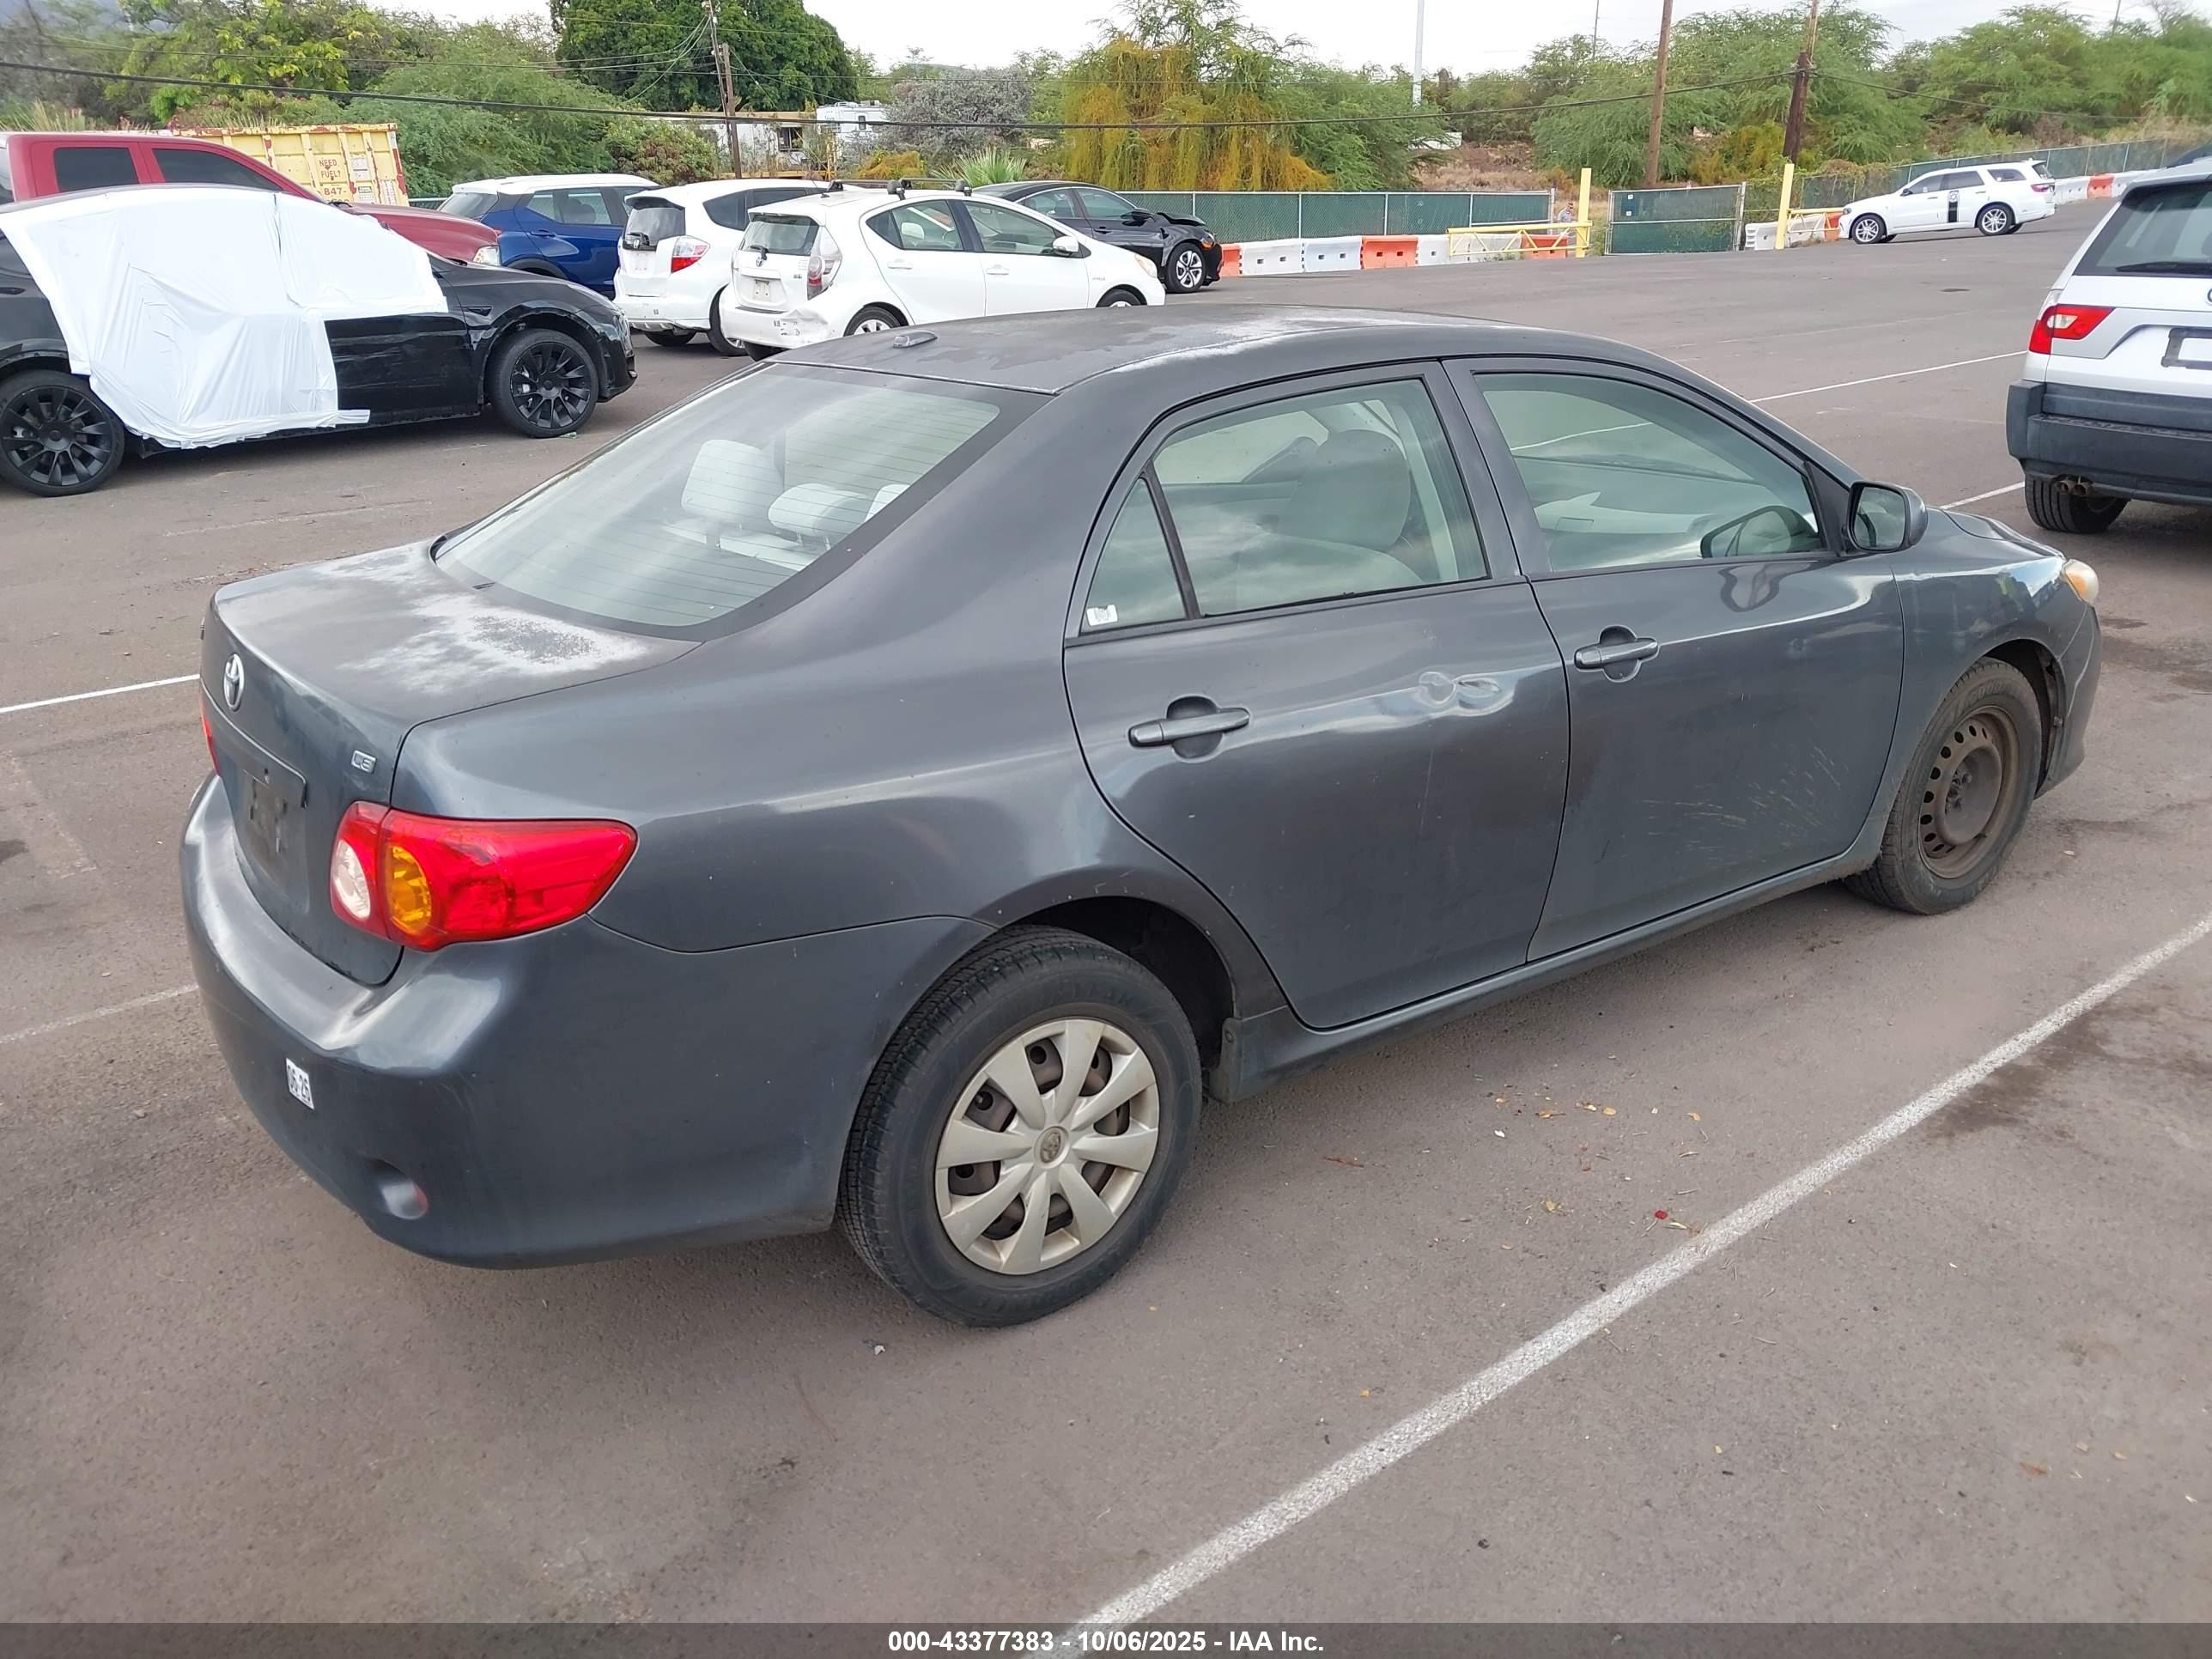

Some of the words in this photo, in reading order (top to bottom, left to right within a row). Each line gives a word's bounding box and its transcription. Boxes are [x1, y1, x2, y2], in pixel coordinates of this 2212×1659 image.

[319, 159, 337, 167] NEED
[320, 170, 341, 179] FUEL?
[351, 750, 376, 773] LE
